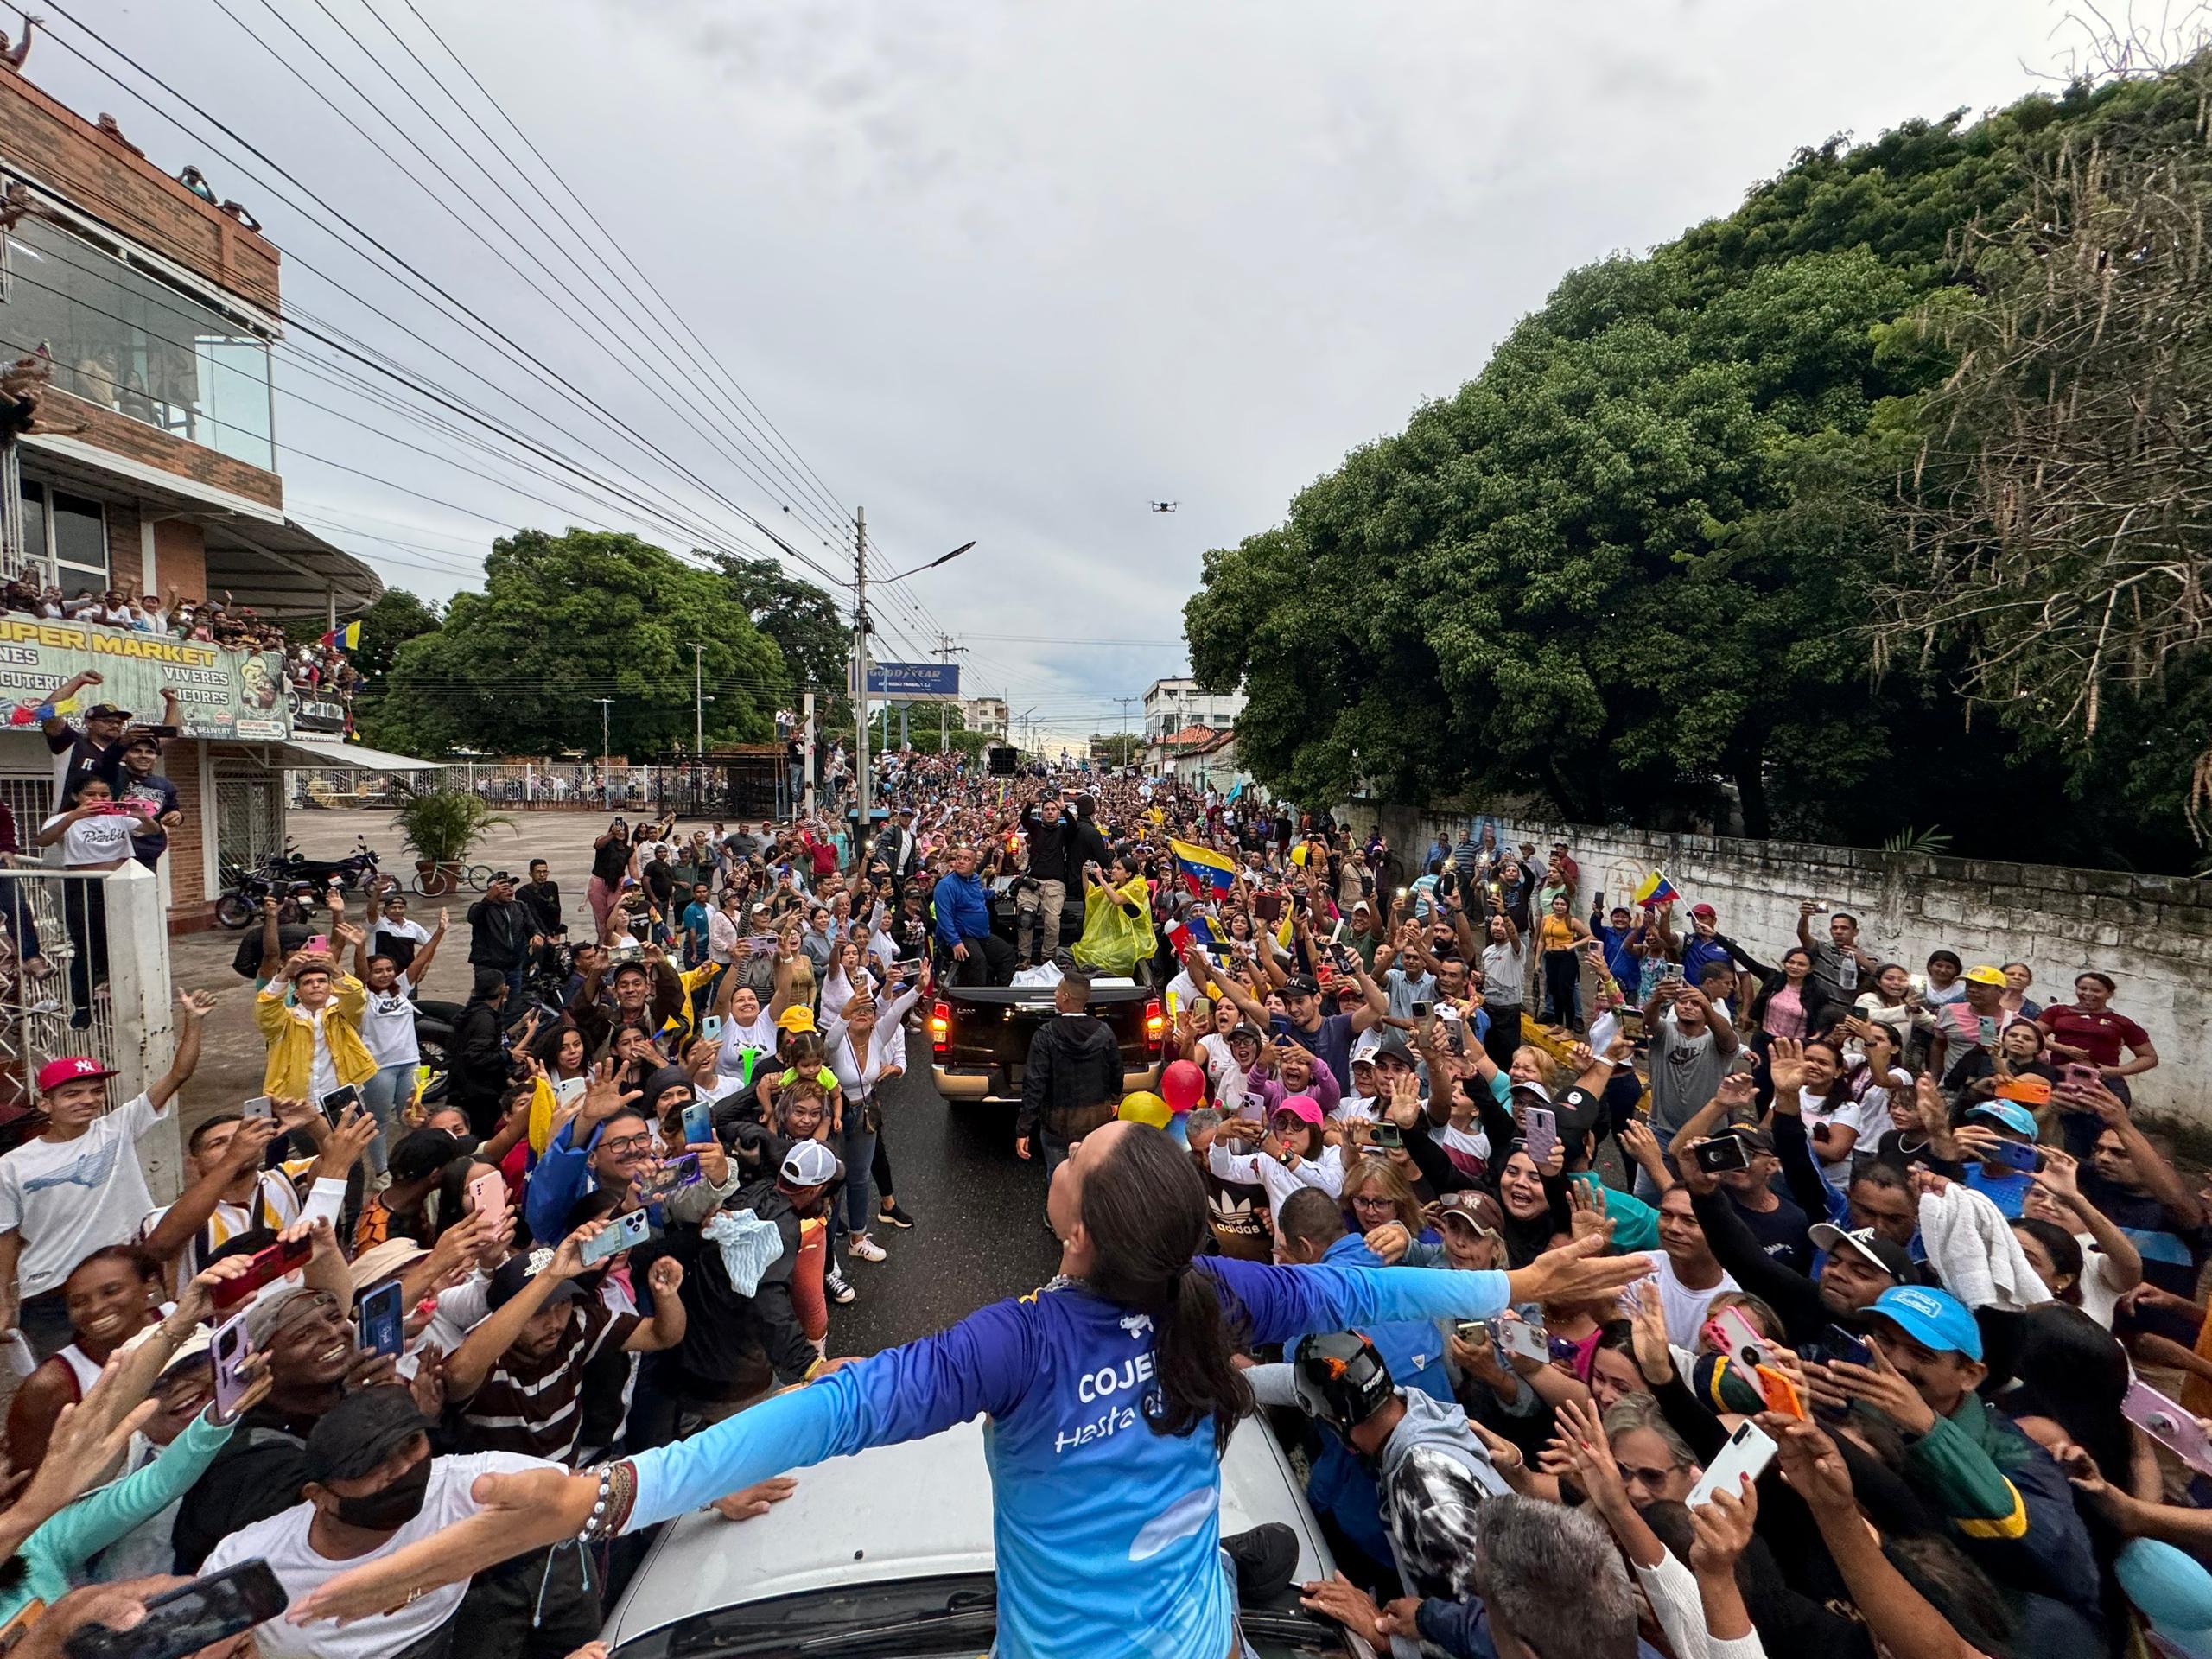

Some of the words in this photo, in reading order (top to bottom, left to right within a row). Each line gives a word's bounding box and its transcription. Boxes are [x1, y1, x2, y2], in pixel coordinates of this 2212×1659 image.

[91, 633, 217, 666] MARKET
[162, 666, 229, 685] VIVERES
[176, 688, 229, 705] ICORES
[197, 726, 232, 734] DELIVERY
[82, 828, 126, 843] Barbie
[1217, 1223, 1260, 1234] adidas
[1079, 1350, 1158, 1403] COJE
[1055, 1406, 1135, 1453] Hasta
